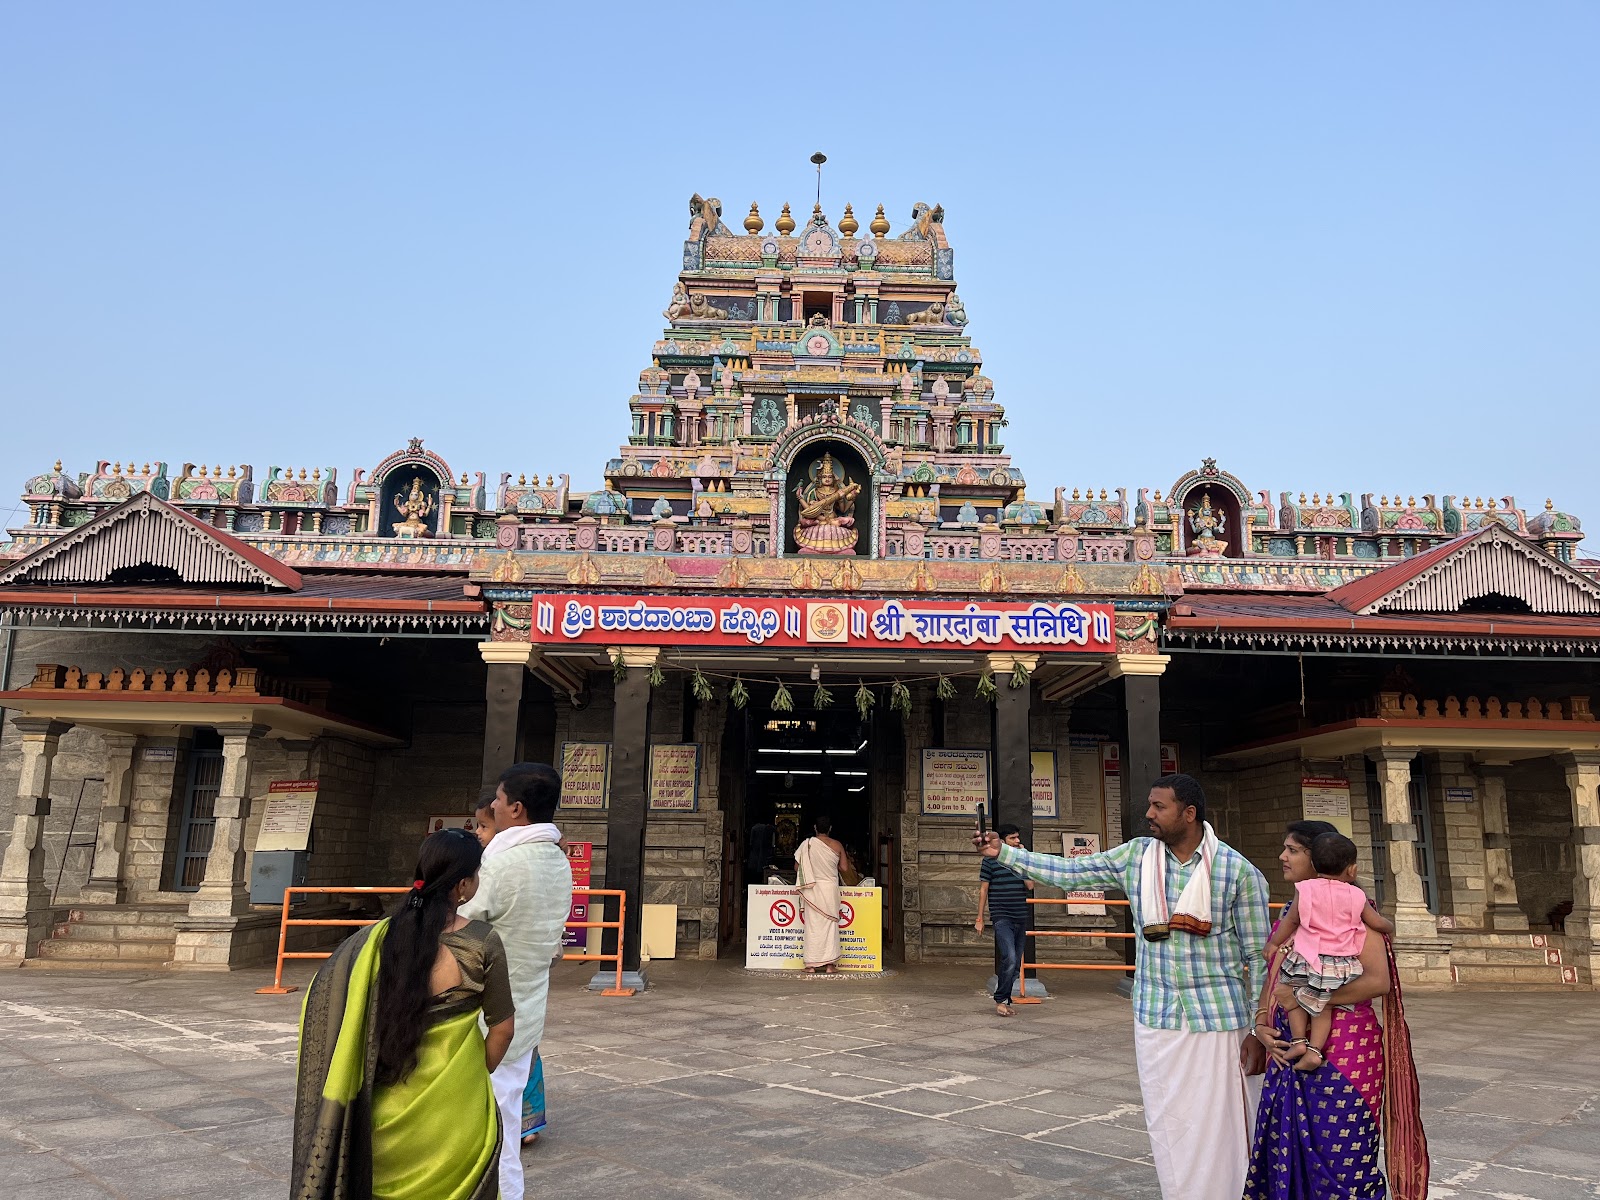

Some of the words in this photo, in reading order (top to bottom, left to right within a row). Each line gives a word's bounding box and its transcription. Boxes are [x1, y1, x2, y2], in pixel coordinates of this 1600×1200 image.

[563, 602, 594, 636] ಶ್ರೀ
[600, 602, 714, 631] ಶಾರದಾಂಬಾ
[722, 606, 778, 641] ಸನ್ನಿಧಿ
[874, 604, 906, 636] श्री
[911, 606, 1001, 640] शारदांबा
[1008, 606, 1087, 639] सन्निधि
[564, 781, 576, 791] KEEP
[1032, 791, 1053, 801] OHIBITED
